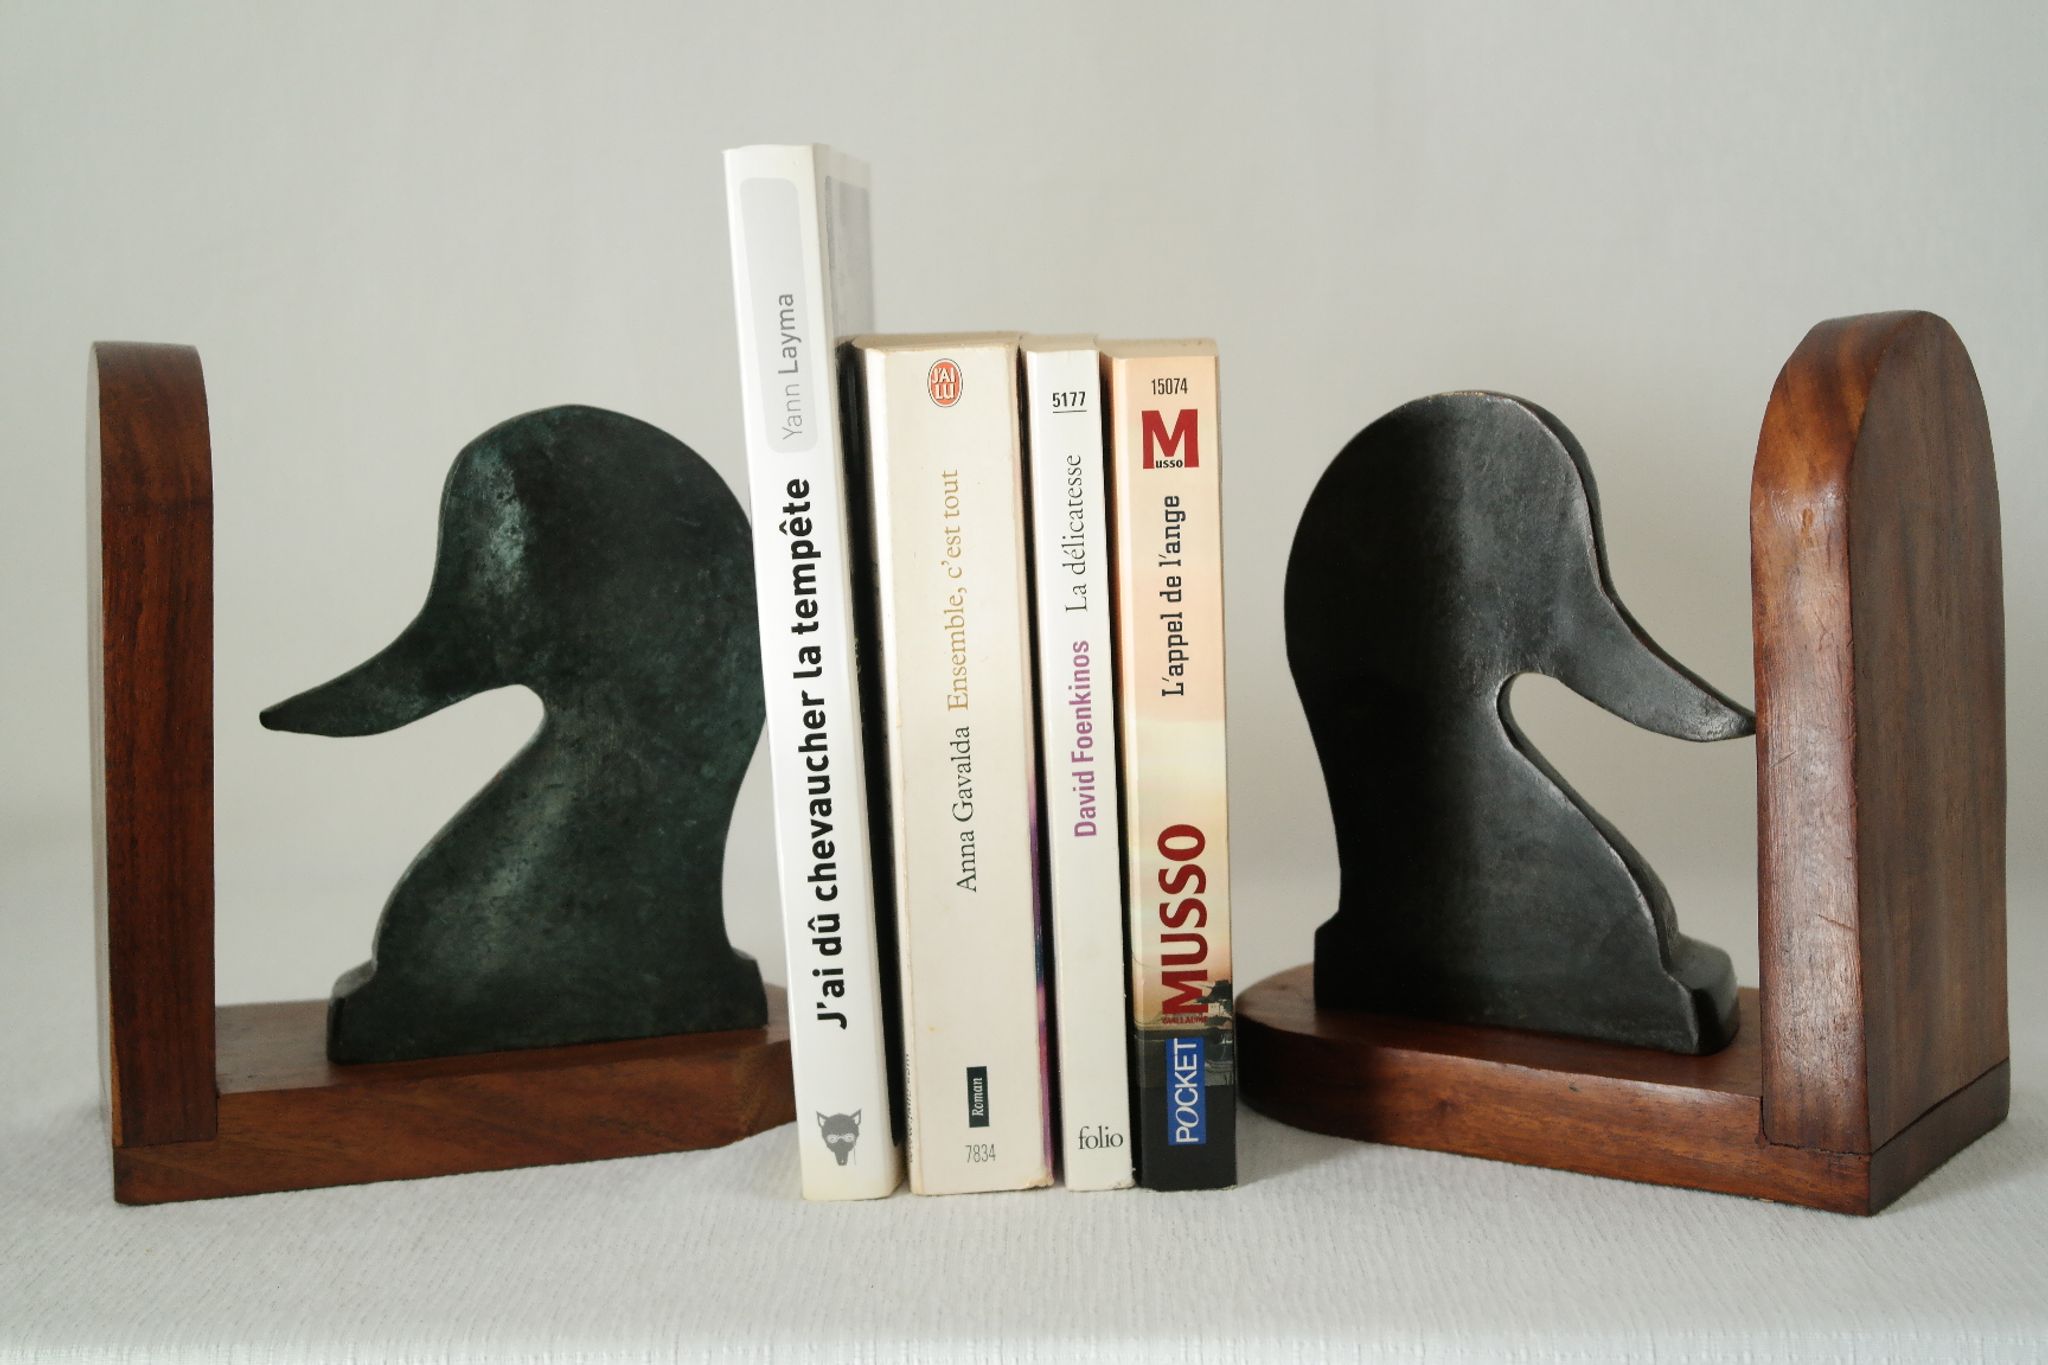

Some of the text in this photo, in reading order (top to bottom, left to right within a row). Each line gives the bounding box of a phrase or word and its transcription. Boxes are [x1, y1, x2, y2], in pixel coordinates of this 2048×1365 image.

[777, 293, 804, 441] Yann Layma
[931, 367, 957, 383] J'AI
[935, 383, 955, 400] LU
[1052, 391, 1087, 408] 5177
[1151, 377, 1189, 396] 15074
[940, 469, 969, 711] Ensemble, c'est tout
[1060, 454, 1088, 613] La délicatesse
[1158, 495, 1190, 698] L'appel de l'ange
[778, 477, 848, 1030] J'ai dû chevaucher la tempête
[1068, 640, 1098, 838] David Foenkinos
[950, 726, 977, 893] Anna Gavalda
[1157, 824, 1208, 1014] MUSSO
[965, 1143, 997, 1163] 7834
[972, 1077, 984, 1117] Roman
[1078, 1125, 1124, 1150] folio
[1174, 1038, 1201, 1144] POCKET
